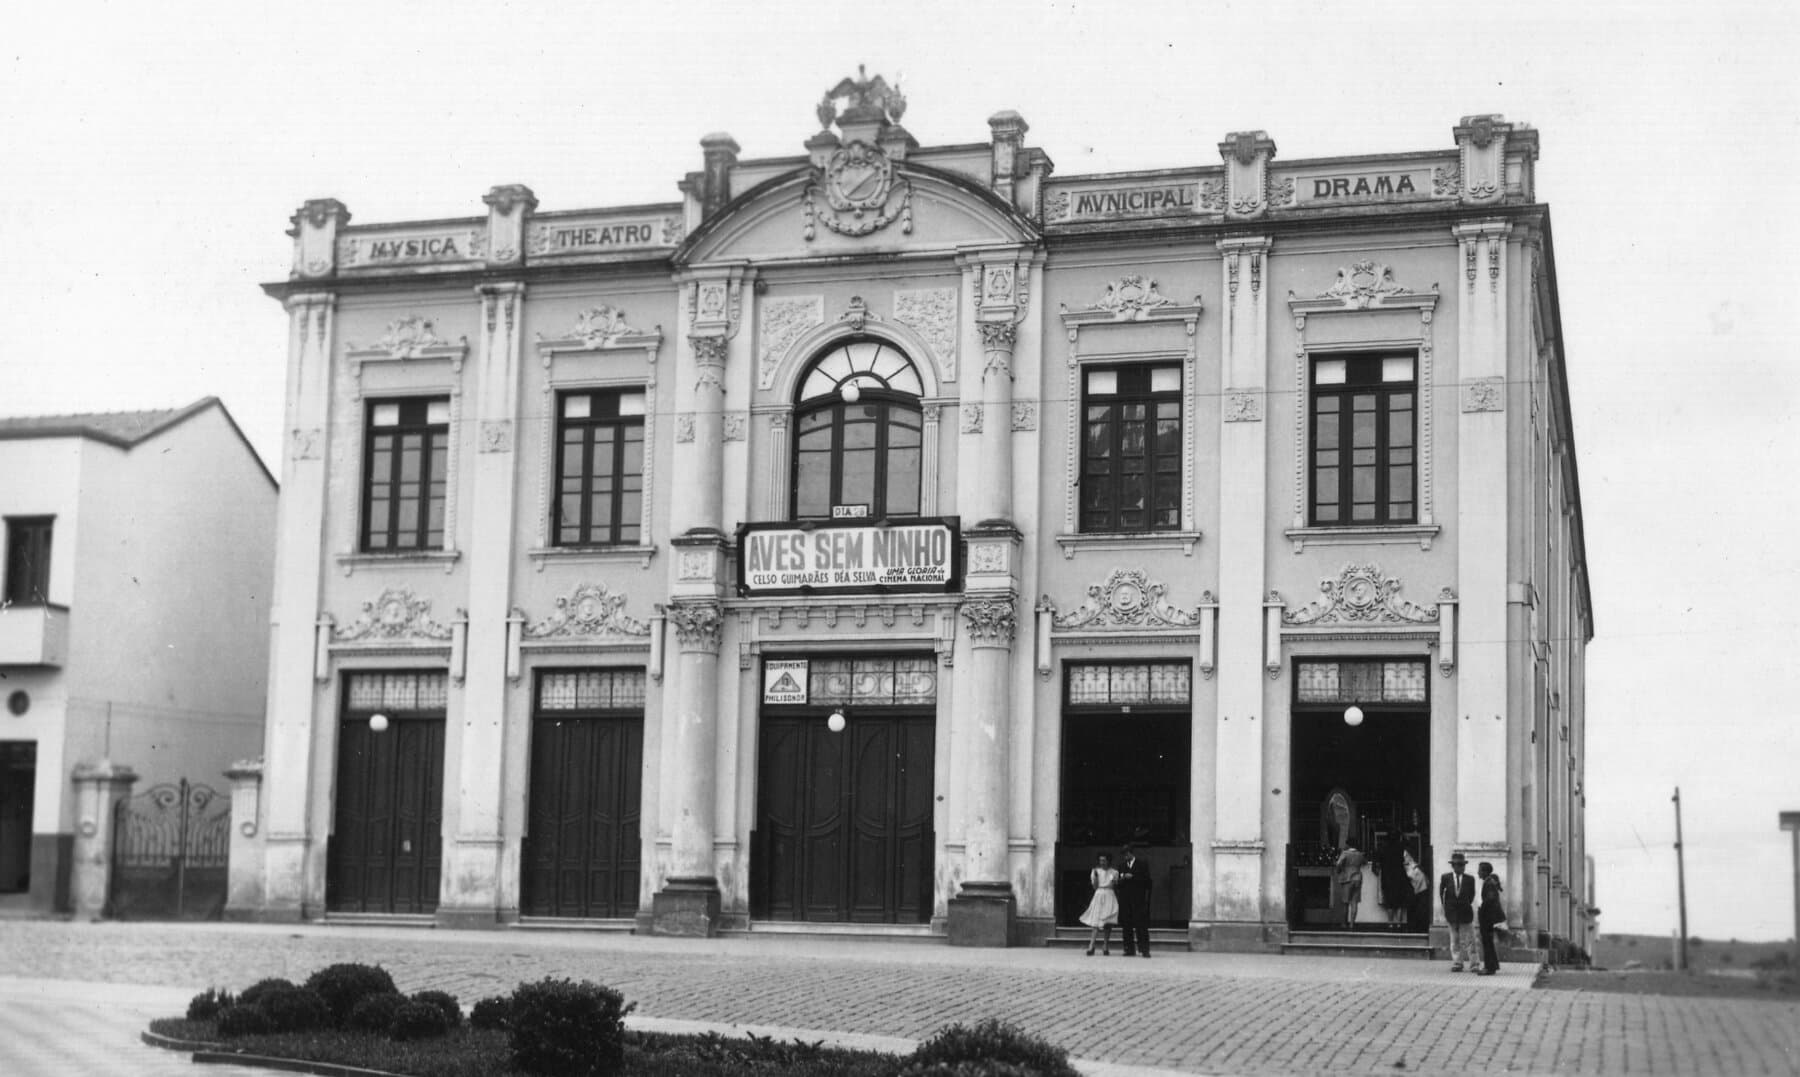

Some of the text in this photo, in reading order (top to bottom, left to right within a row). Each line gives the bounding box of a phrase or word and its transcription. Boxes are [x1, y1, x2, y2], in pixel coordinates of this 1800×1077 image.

[1313, 173, 1415, 198] DRAMA
[558, 223, 652, 248] THEATRO
[834, 507, 852, 516] DIA
[748, 529, 947, 572] AVES SEM NINHO
[753, 570, 877, 585] CELSO GUIMARÃES DÉA SELVA
[879, 574, 945, 583] CINEMA NACIONAL
[886, 567, 905, 576] UMA
